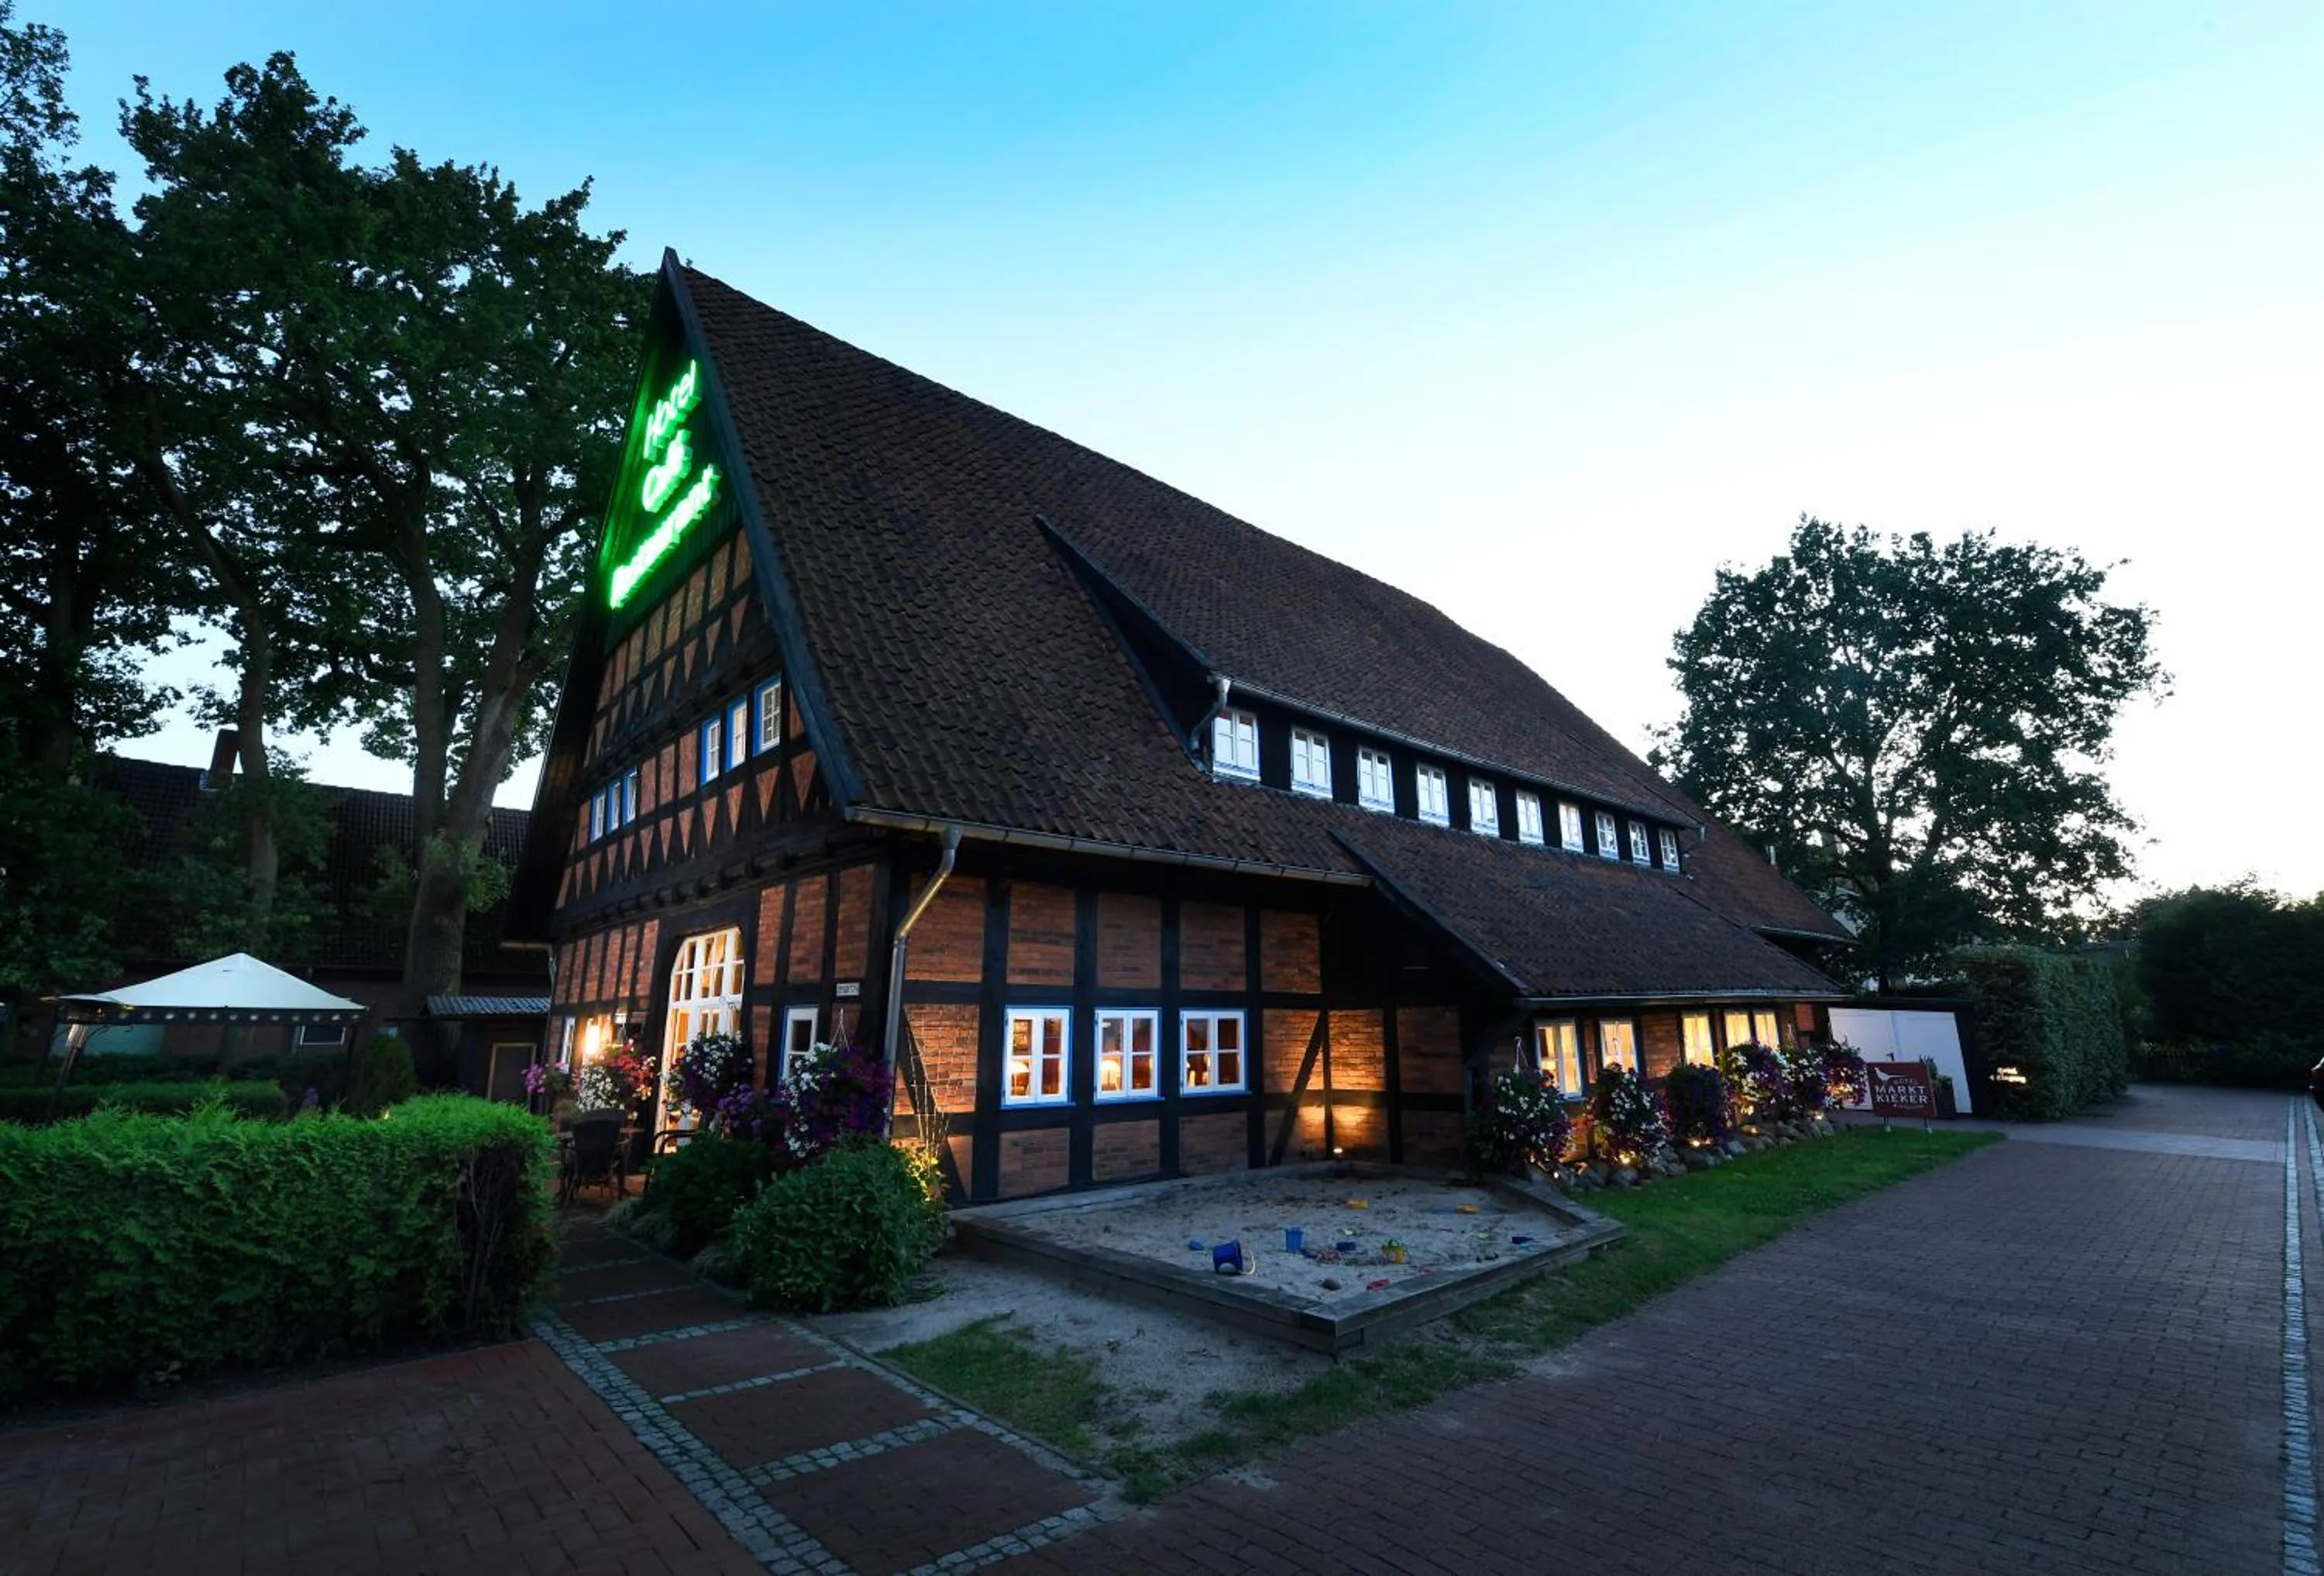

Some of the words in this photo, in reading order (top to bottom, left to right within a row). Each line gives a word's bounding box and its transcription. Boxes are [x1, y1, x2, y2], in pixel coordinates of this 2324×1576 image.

[643, 359, 696, 459] Hotel
[1875, 1085, 1925, 1094] MARKT
[1875, 1094, 1928, 1103] KIEKER
